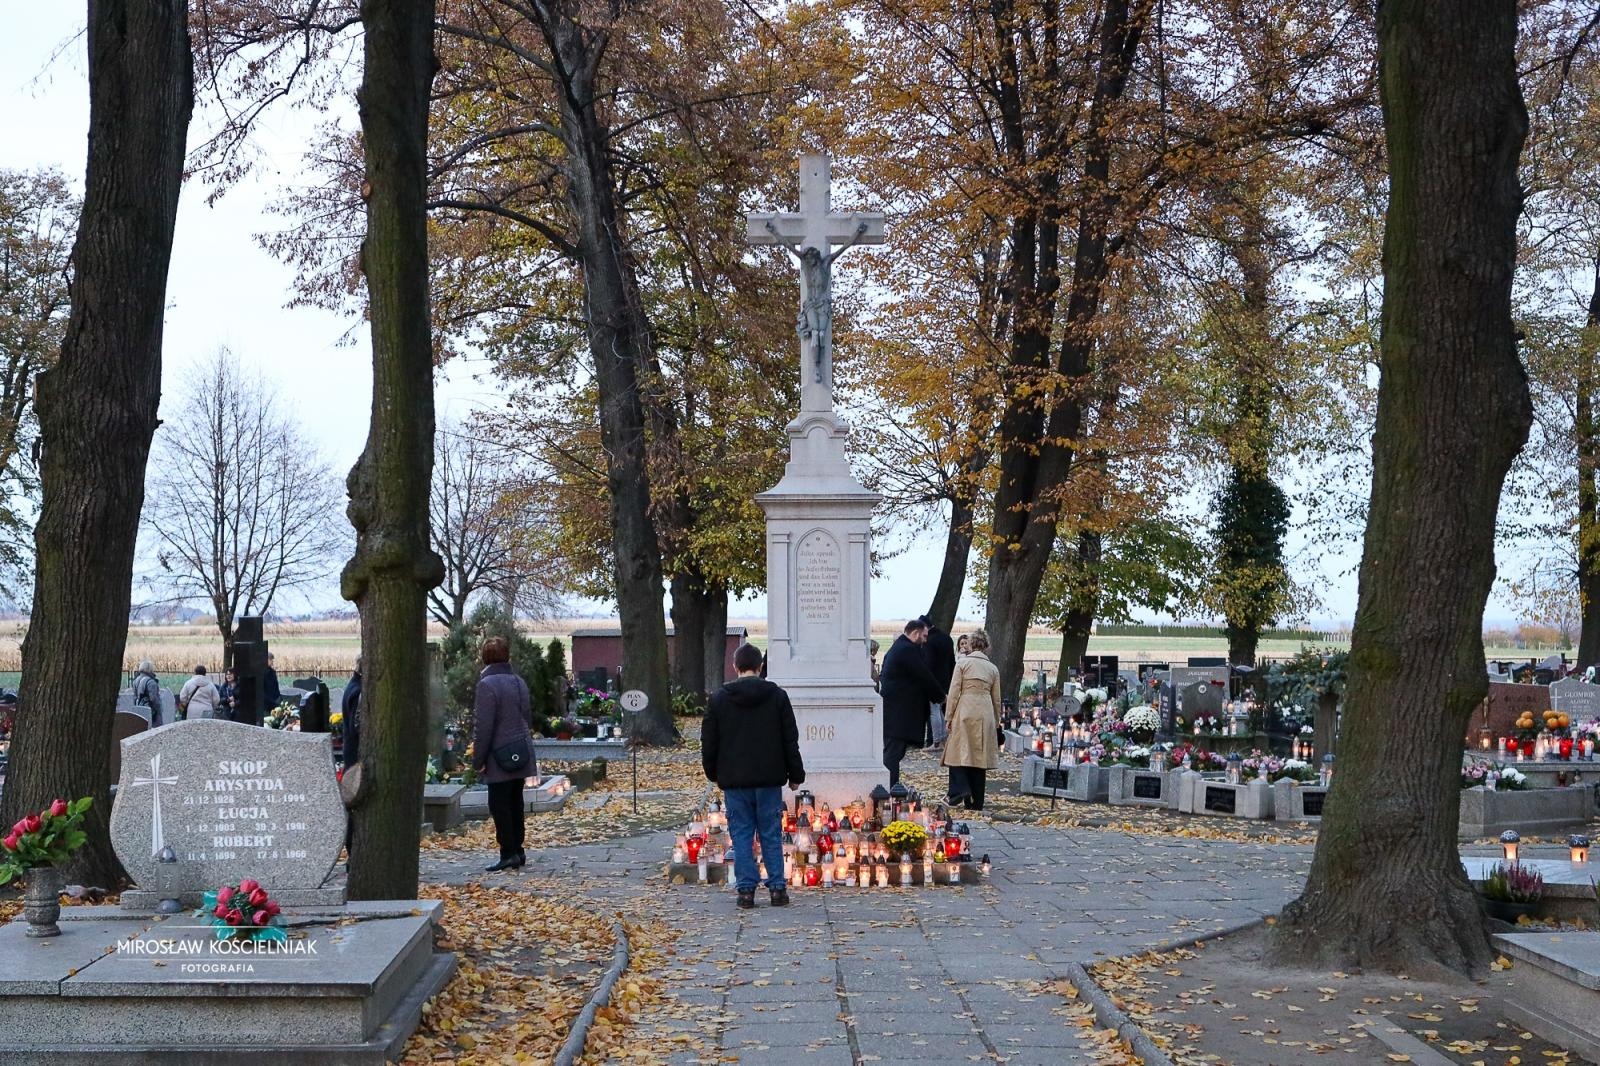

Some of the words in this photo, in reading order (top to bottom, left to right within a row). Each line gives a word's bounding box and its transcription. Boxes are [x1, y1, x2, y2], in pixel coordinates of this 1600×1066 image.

[630, 699, 638, 707] G
[806, 724, 834, 741] 1908
[219, 760, 268, 775] SKOP
[204, 778, 284, 792] ARYSTYDA
[218, 807, 269, 819] ŁUCJA
[213, 835, 274, 848] ROBERT
